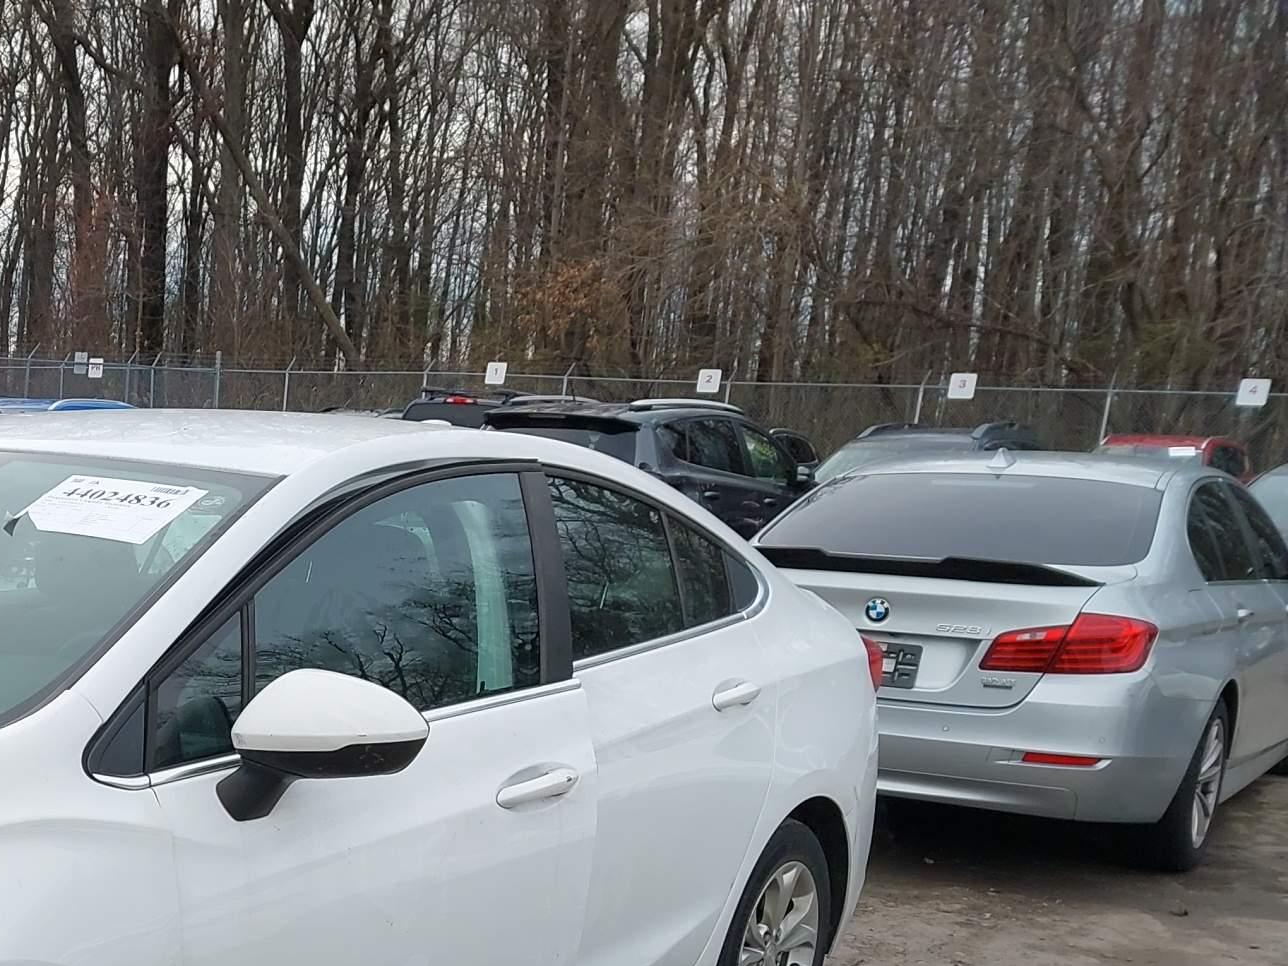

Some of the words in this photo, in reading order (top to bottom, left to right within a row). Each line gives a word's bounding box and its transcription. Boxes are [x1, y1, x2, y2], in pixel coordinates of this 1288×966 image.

[705, 374, 713, 383] 2
[959, 379, 967, 389] 3
[1249, 385, 1258, 394] 4
[63, 487, 171, 509] 44024836
